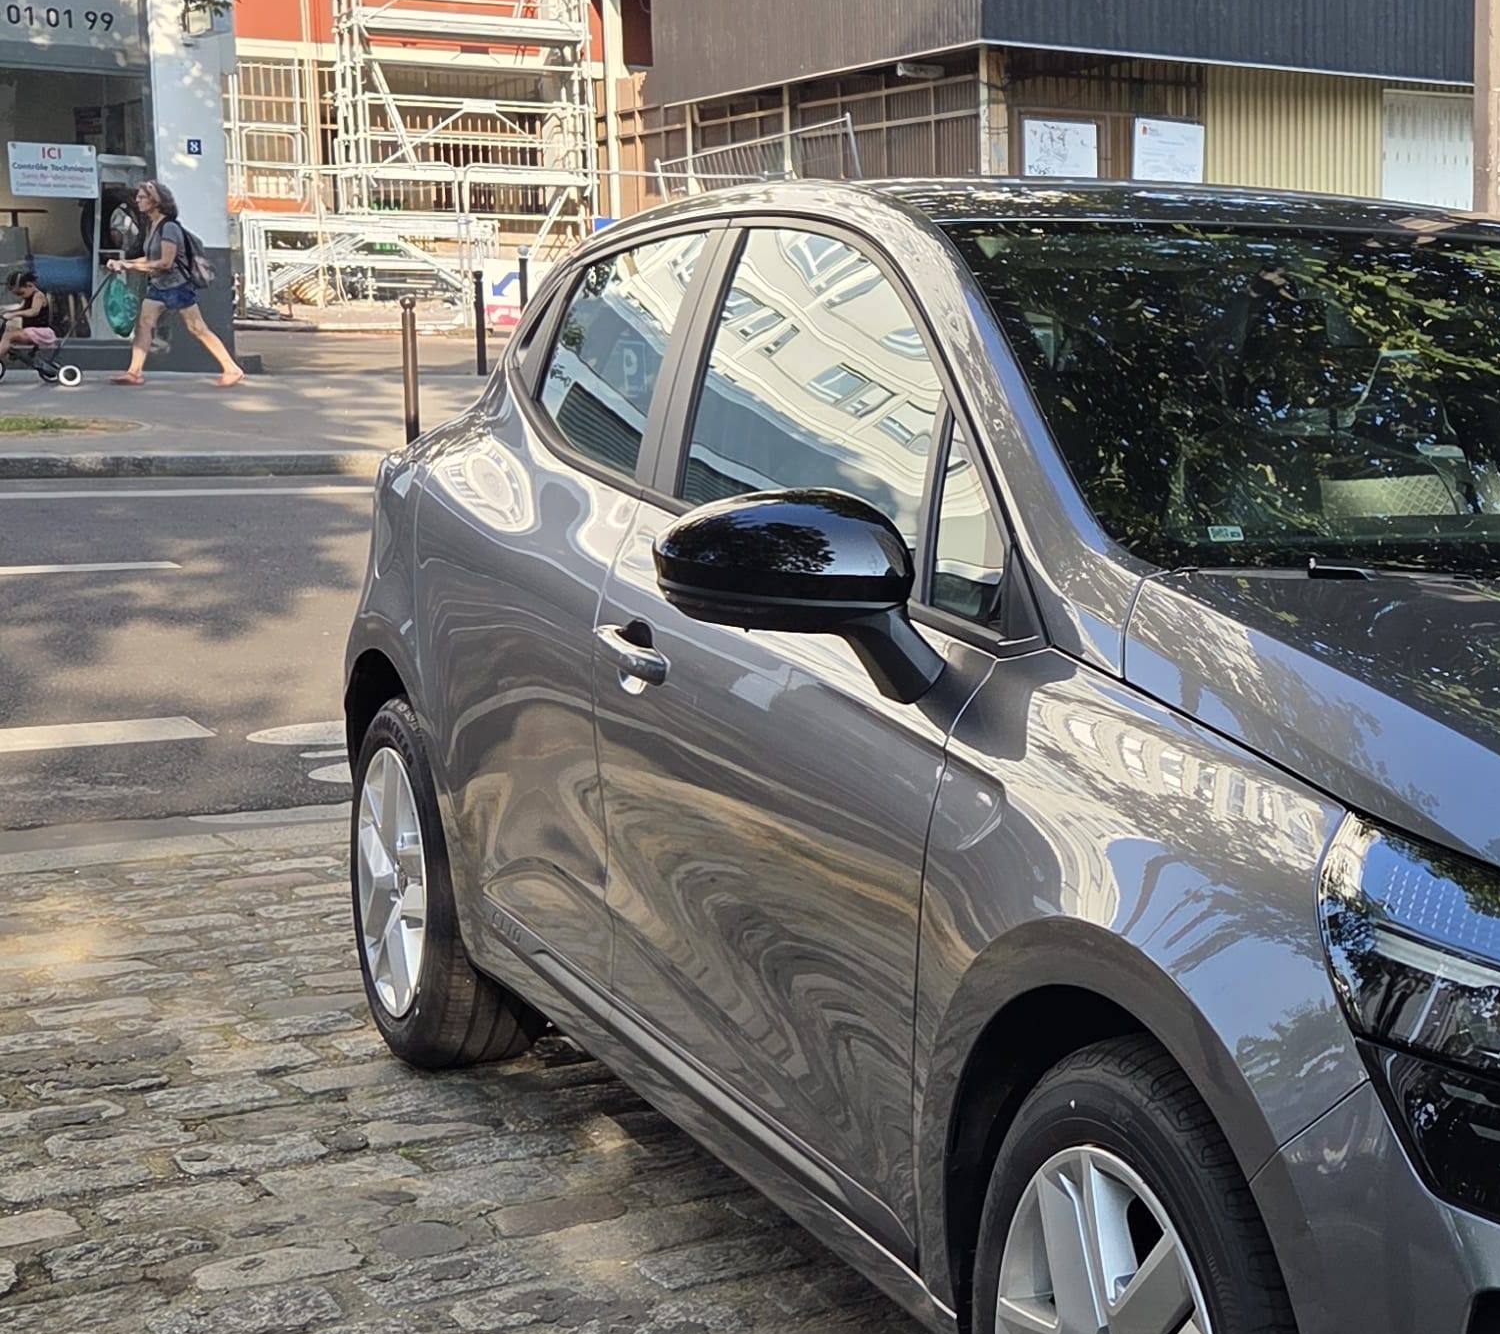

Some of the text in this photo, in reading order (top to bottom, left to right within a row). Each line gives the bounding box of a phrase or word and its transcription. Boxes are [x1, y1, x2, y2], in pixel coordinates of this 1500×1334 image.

[7, 4, 114, 32] 01 01 99
[41, 146, 62, 160] ICI
[12, 161, 94, 173] Contrôle Technique
